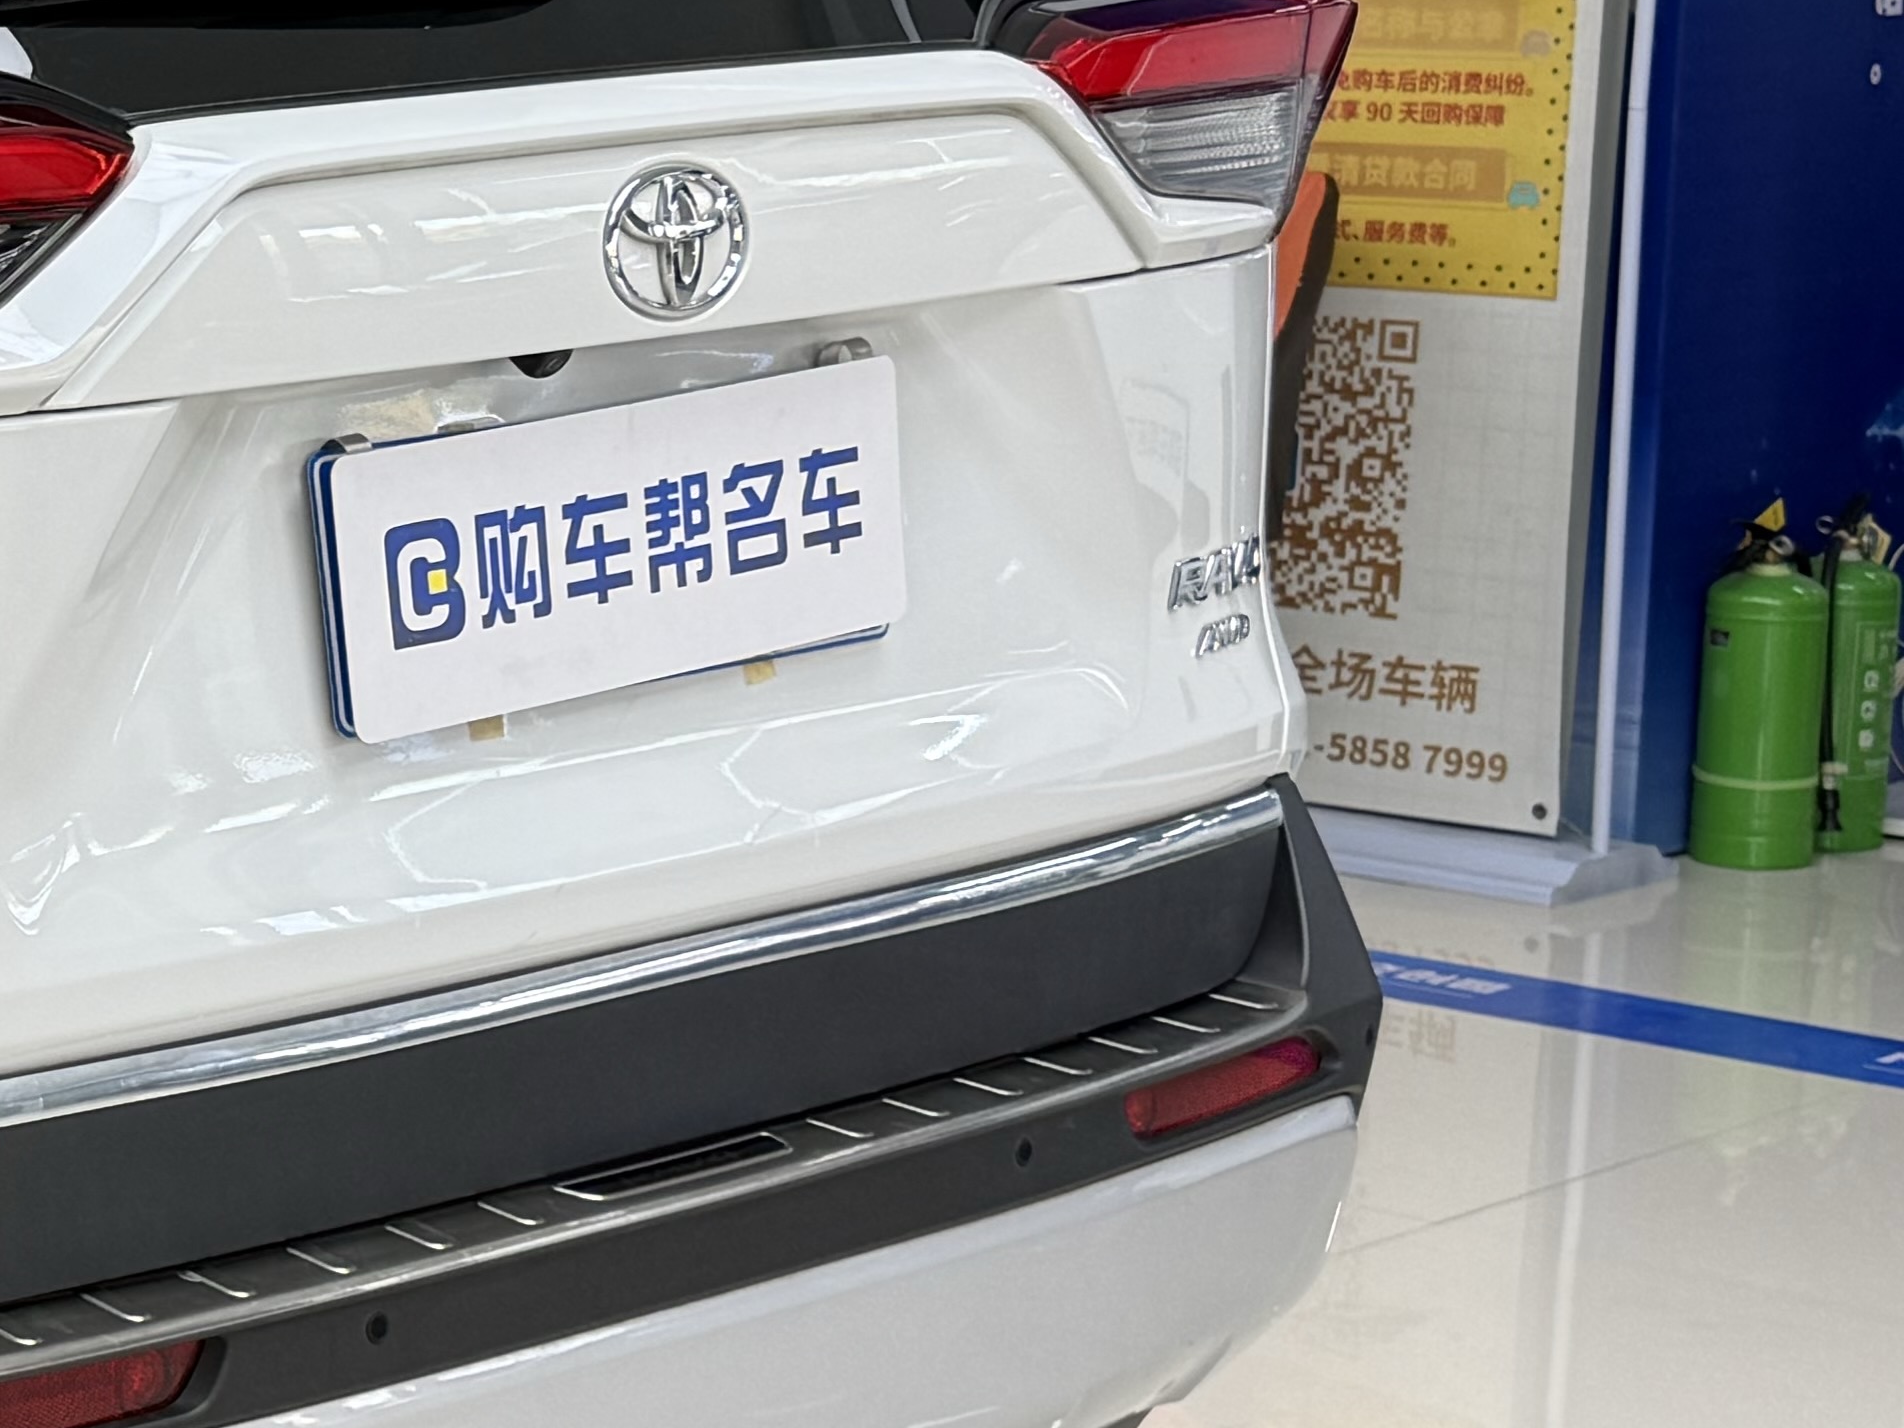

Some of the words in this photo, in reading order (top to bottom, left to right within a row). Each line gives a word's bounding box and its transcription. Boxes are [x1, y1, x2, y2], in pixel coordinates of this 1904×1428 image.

[474, 445, 864, 630] 购车帮名车
[1292, 644, 1481, 714] 全场车辆
[1423, 743, 1508, 784] 7999
